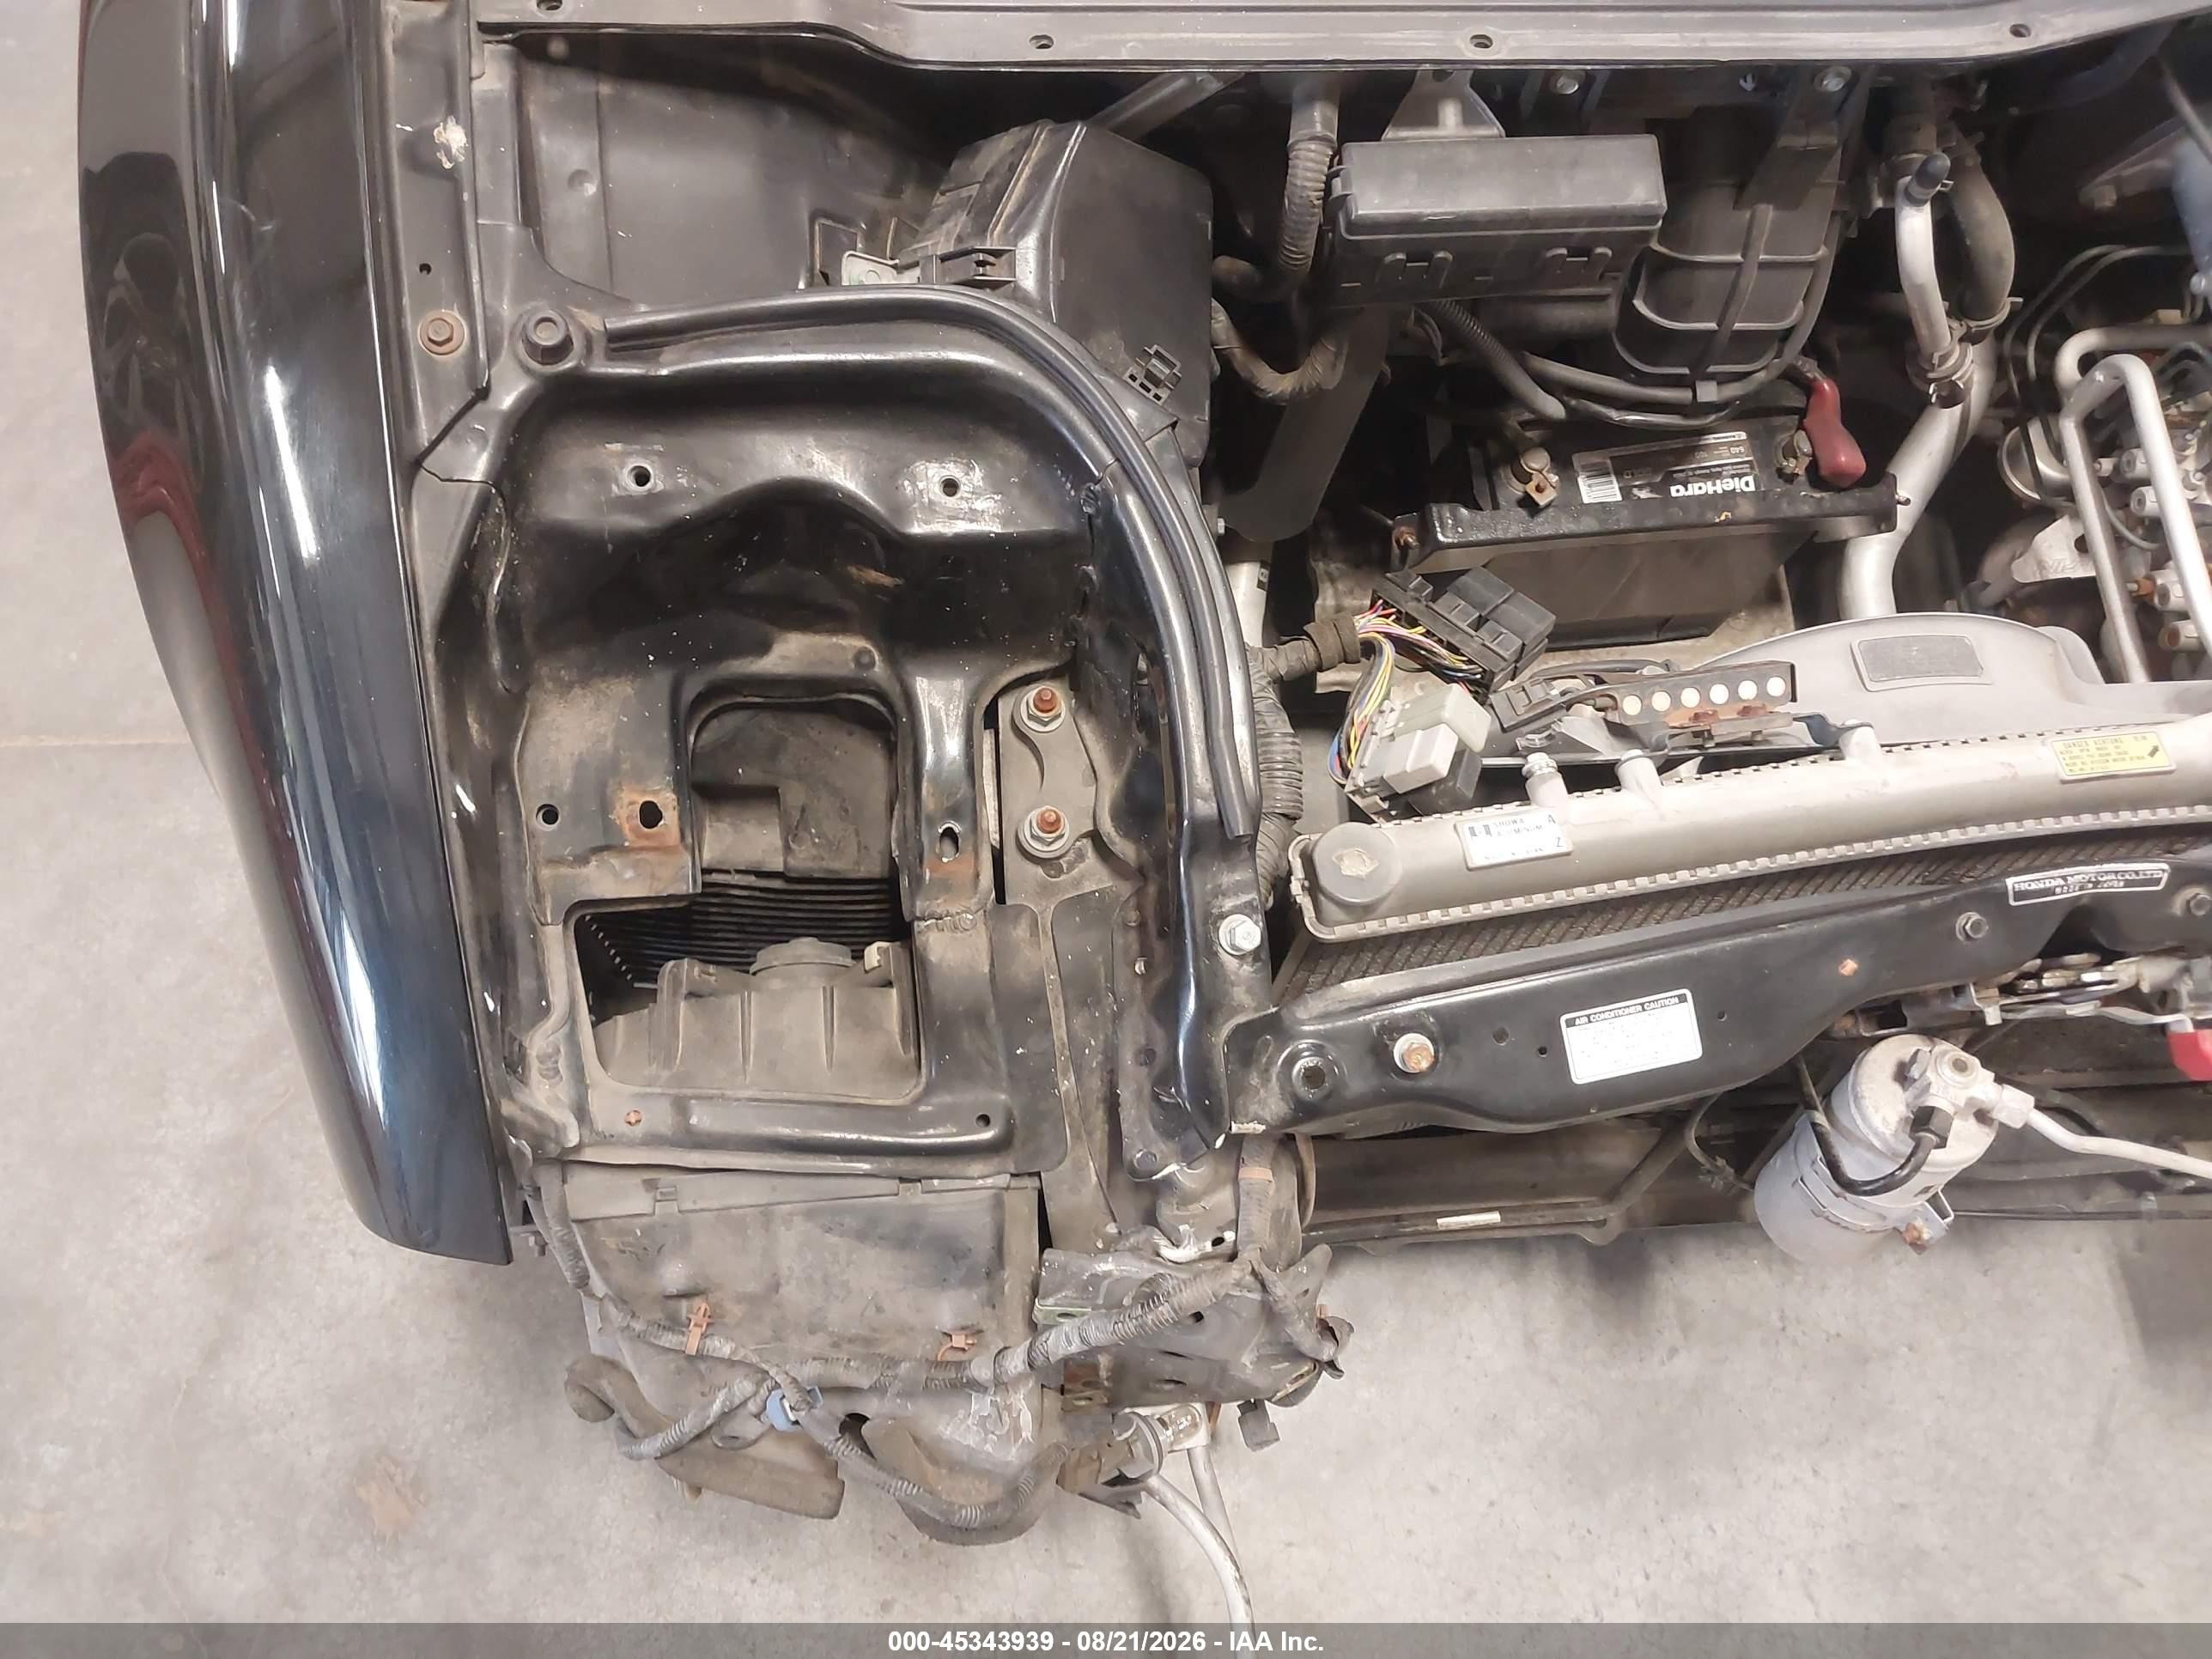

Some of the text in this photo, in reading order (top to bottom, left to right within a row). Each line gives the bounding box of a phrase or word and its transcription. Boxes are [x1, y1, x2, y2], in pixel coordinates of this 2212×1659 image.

[2014, 878, 2066, 891] HONDA
[2067, 872, 2117, 884] MOTOR
[1575, 996, 1680, 1026] AIR CONDITIONER CAUTION
